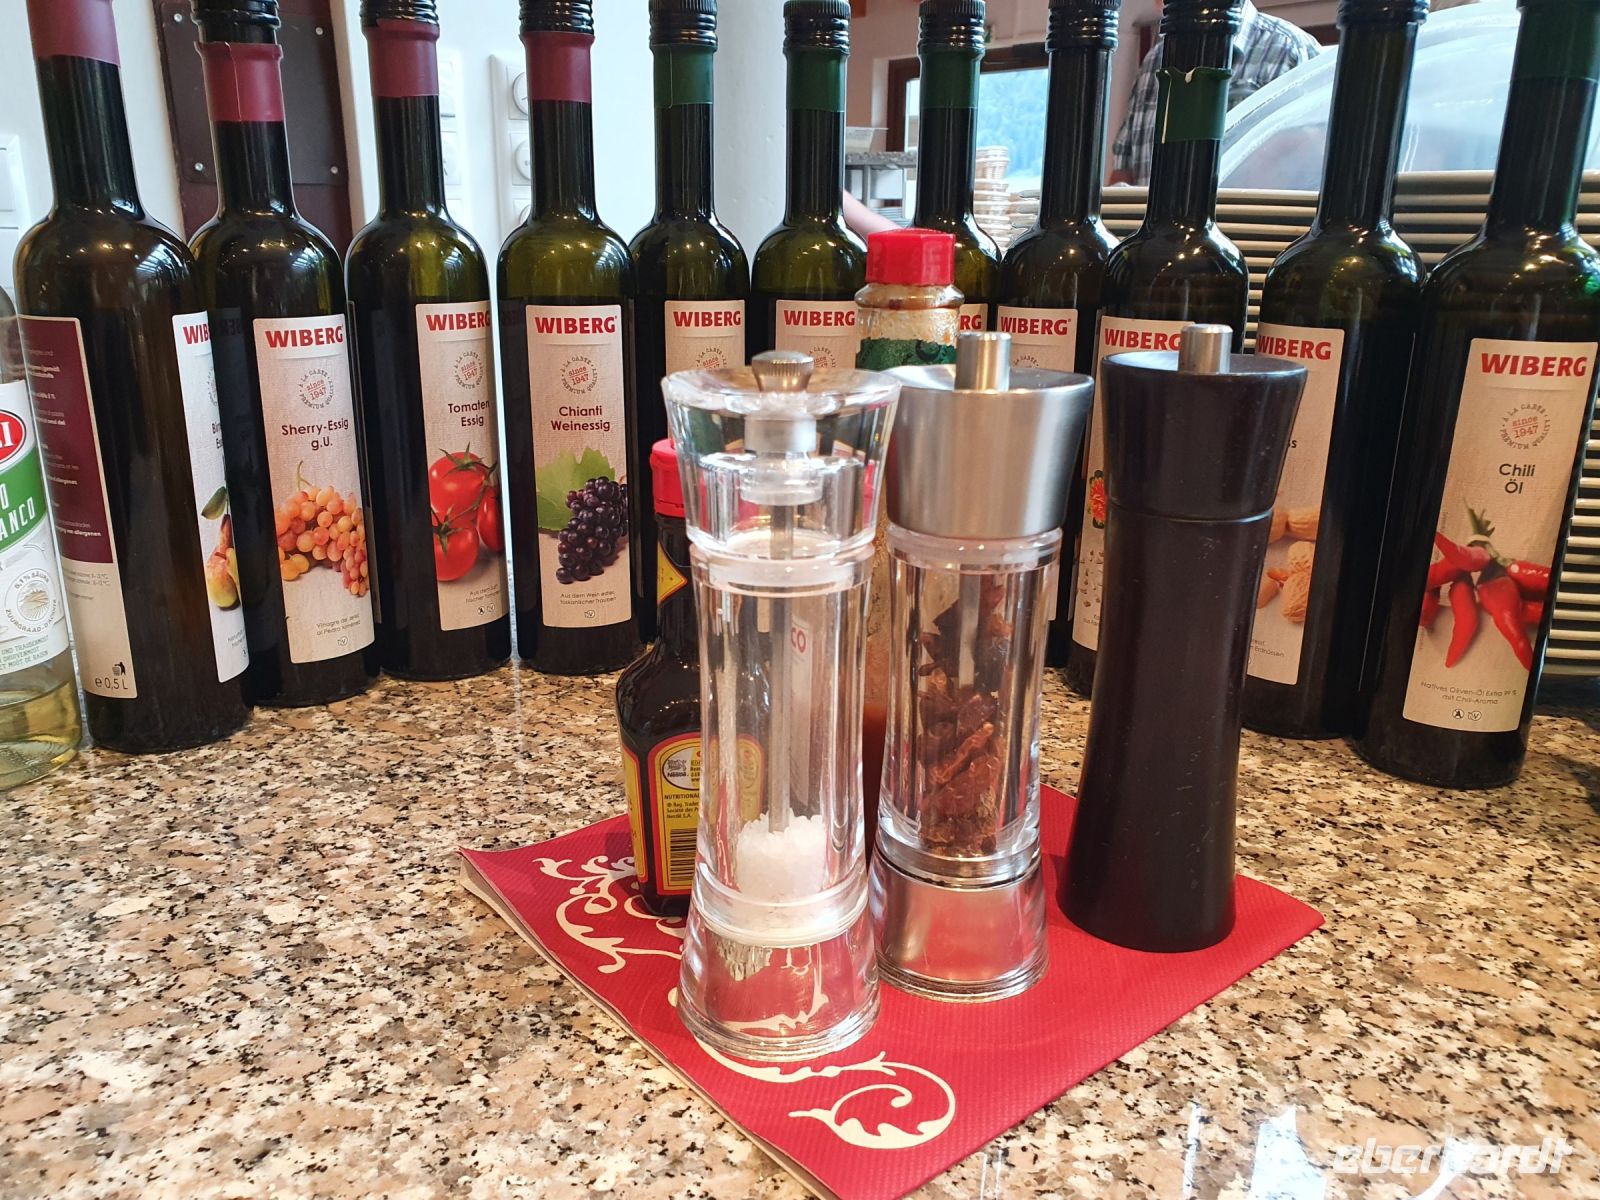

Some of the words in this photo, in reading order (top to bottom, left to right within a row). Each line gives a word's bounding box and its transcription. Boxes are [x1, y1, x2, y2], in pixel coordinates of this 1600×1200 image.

[426, 311, 490, 332] WIBERG
[534, 316, 616, 334] WIBERG
[673, 311, 741, 327] WIBERG
[784, 310, 856, 327] WIBERG
[960, 314, 982, 330] RG
[1000, 317, 1068, 335] WIBERG
[183, 323, 210, 345] WIB
[265, 325, 344, 348] WIBERG
[1104, 328, 1182, 351] WIBERG
[1257, 335, 1332, 360] WIBERG
[1481, 353, 1588, 377] WIBERG
[571, 373, 589, 386] 1947
[309, 386, 327, 400] 1947
[448, 400, 490, 413] Tomaten
[559, 405, 602, 417] Chianti
[282, 418, 349, 436] Sherry-Essig
[461, 416, 484, 427] Essig
[551, 420, 610, 432] Weinessig
[1513, 424, 1539, 439] 1947
[311, 437, 333, 451] g.U.
[1499, 464, 1536, 477] Chili
[1504, 478, 1523, 494] Öl
[0, 497, 36, 545] ANCO
[316, 619, 339, 628] Vinagre
[1421, 681, 1448, 692] Natives
